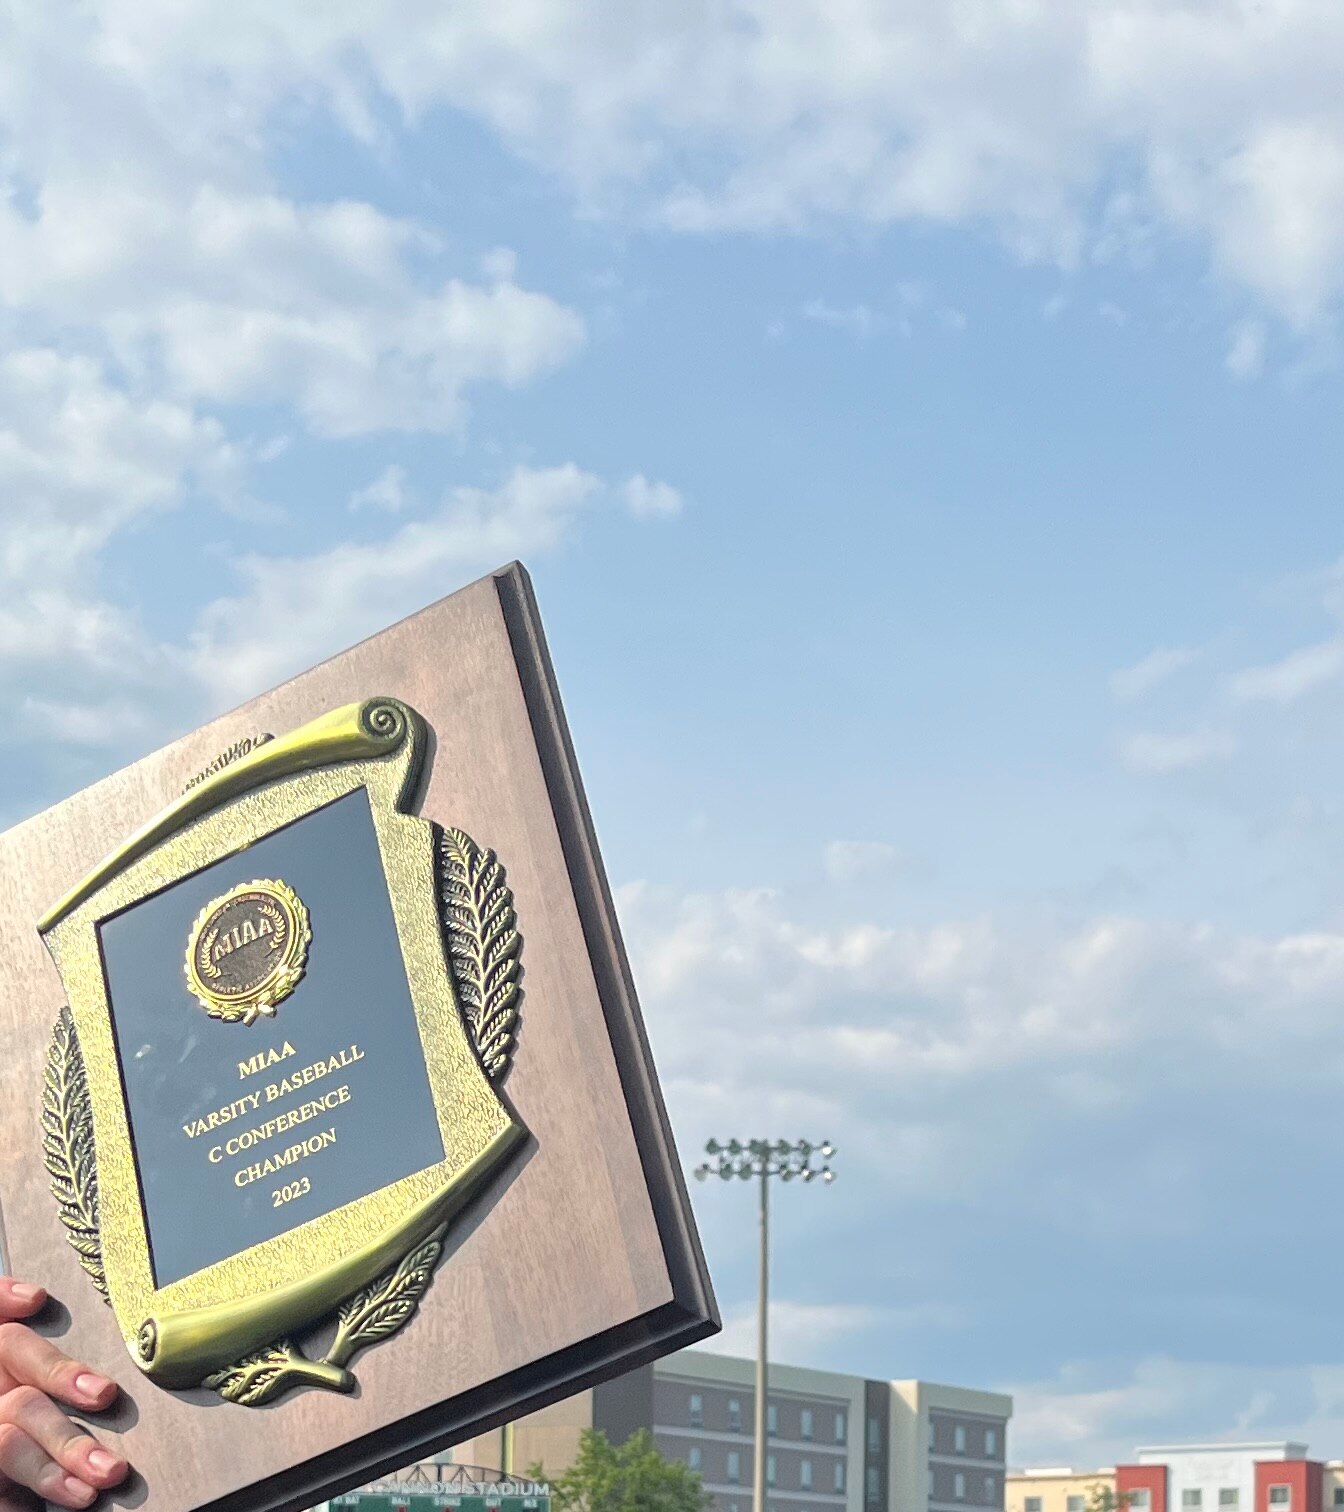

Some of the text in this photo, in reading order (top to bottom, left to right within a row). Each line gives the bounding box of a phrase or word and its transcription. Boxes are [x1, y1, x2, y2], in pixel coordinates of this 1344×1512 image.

[214, 918, 274, 961] MIAA
[237, 1041, 297, 1080] MIAA
[182, 1044, 366, 1140] VARSITY BASEBALL
[207, 1085, 352, 1164] C CONFERENCE
[233, 1128, 338, 1188] CHAMPION
[271, 1177, 312, 1208] 2023
[462, 1482, 550, 1496] STADIUM
